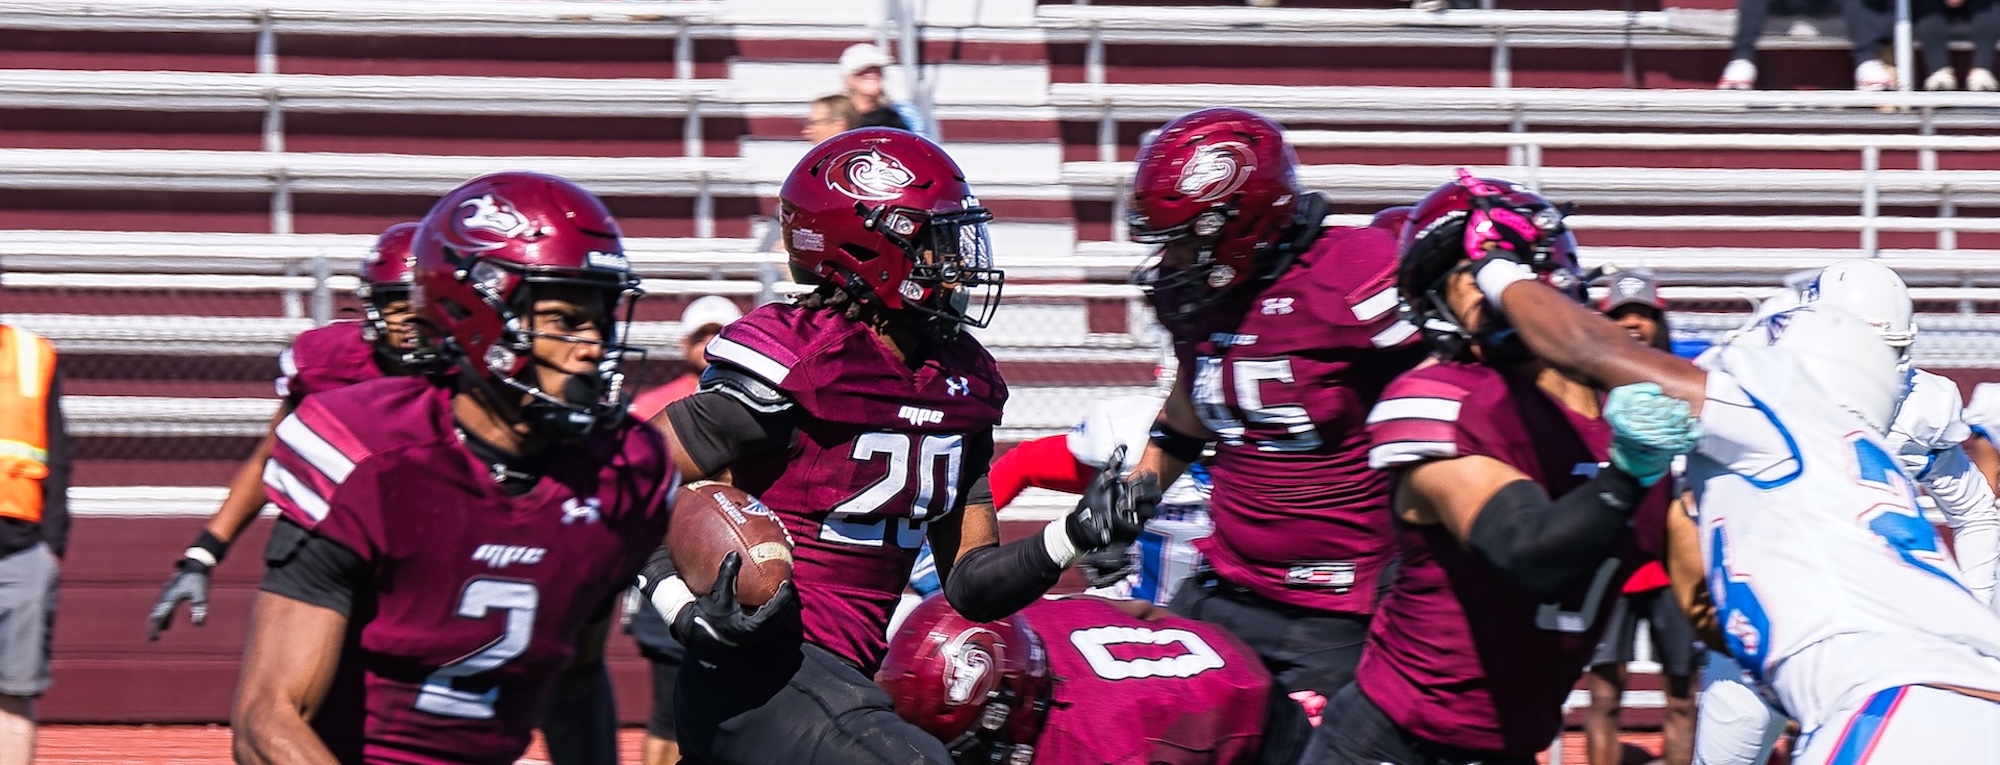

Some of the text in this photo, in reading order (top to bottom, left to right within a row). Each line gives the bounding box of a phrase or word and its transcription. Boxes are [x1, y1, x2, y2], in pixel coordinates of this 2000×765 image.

[819, 432, 963, 549] 20
[415, 577, 540, 719] 2
[1070, 625, 1226, 681] 0
